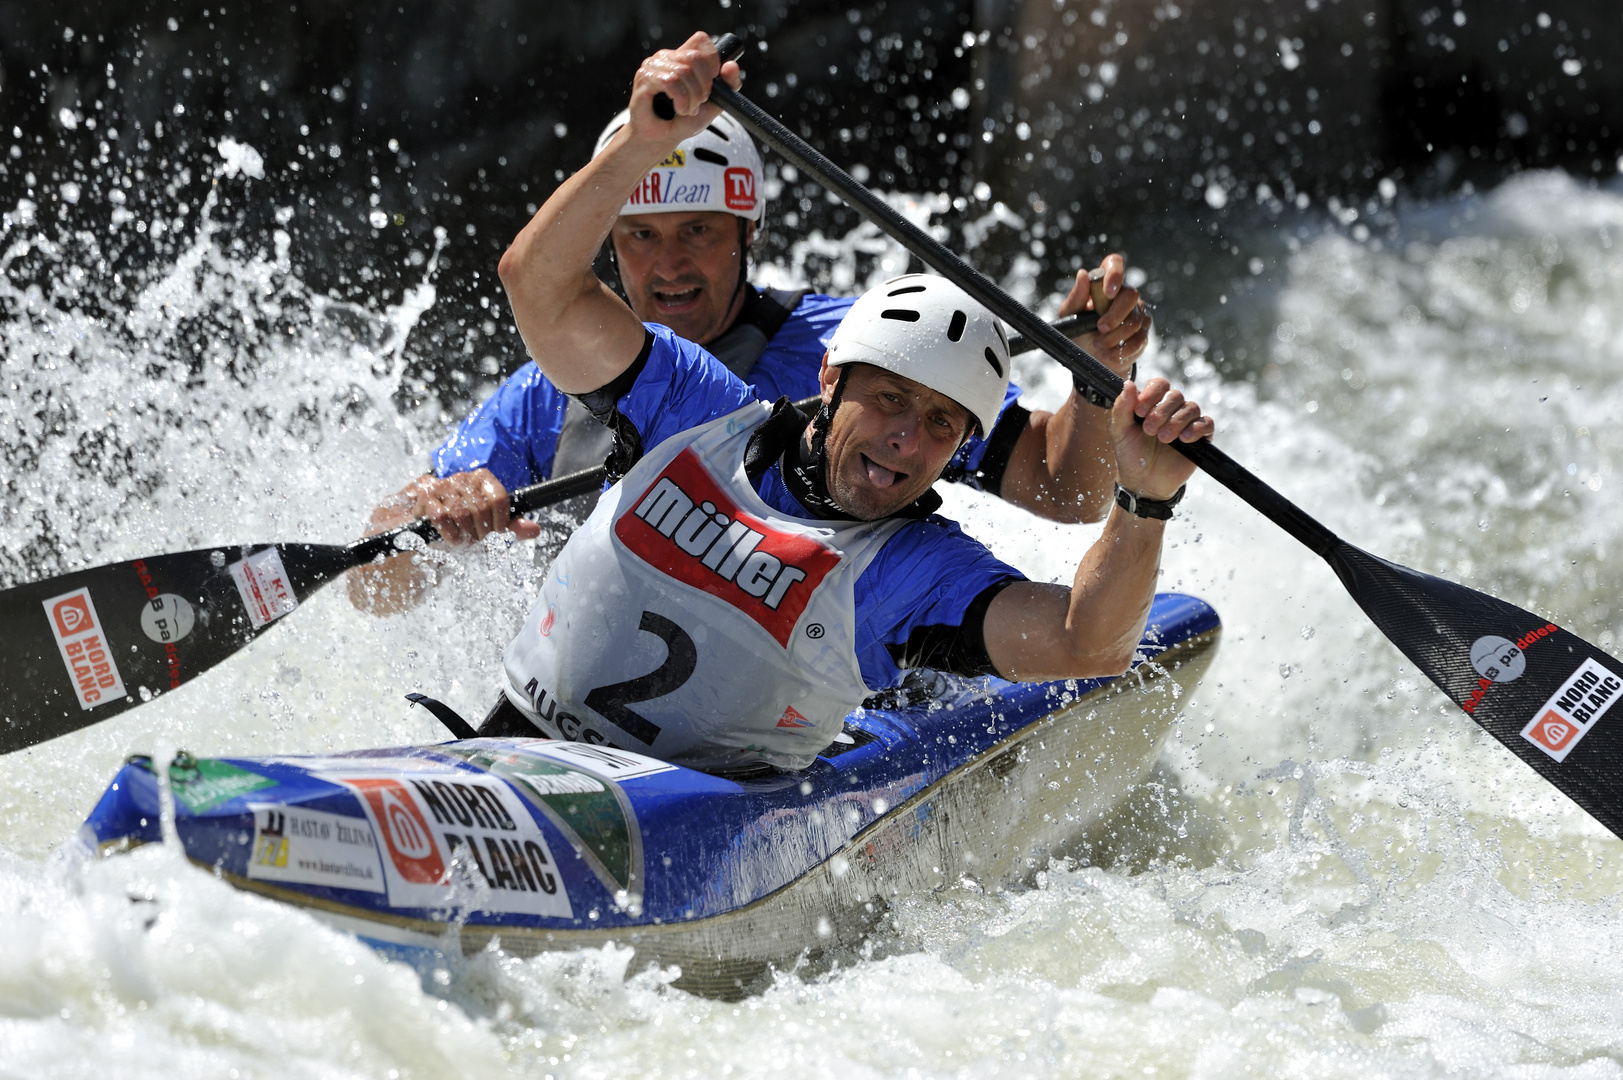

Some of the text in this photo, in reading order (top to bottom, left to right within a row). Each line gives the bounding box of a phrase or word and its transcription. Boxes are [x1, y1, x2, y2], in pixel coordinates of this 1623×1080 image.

[729, 173, 753, 197] TV
[633, 476, 808, 612] müller
[133, 559, 181, 690] RAAB paddles
[64, 641, 102, 704] BLANC
[83, 635, 116, 690] NORD
[584, 611, 697, 747] 2
[1462, 622, 1558, 713] RAAB paddles
[1556, 670, 1600, 713] NORD
[1572, 676, 1621, 725] BLANC
[409, 779, 517, 831] NORD
